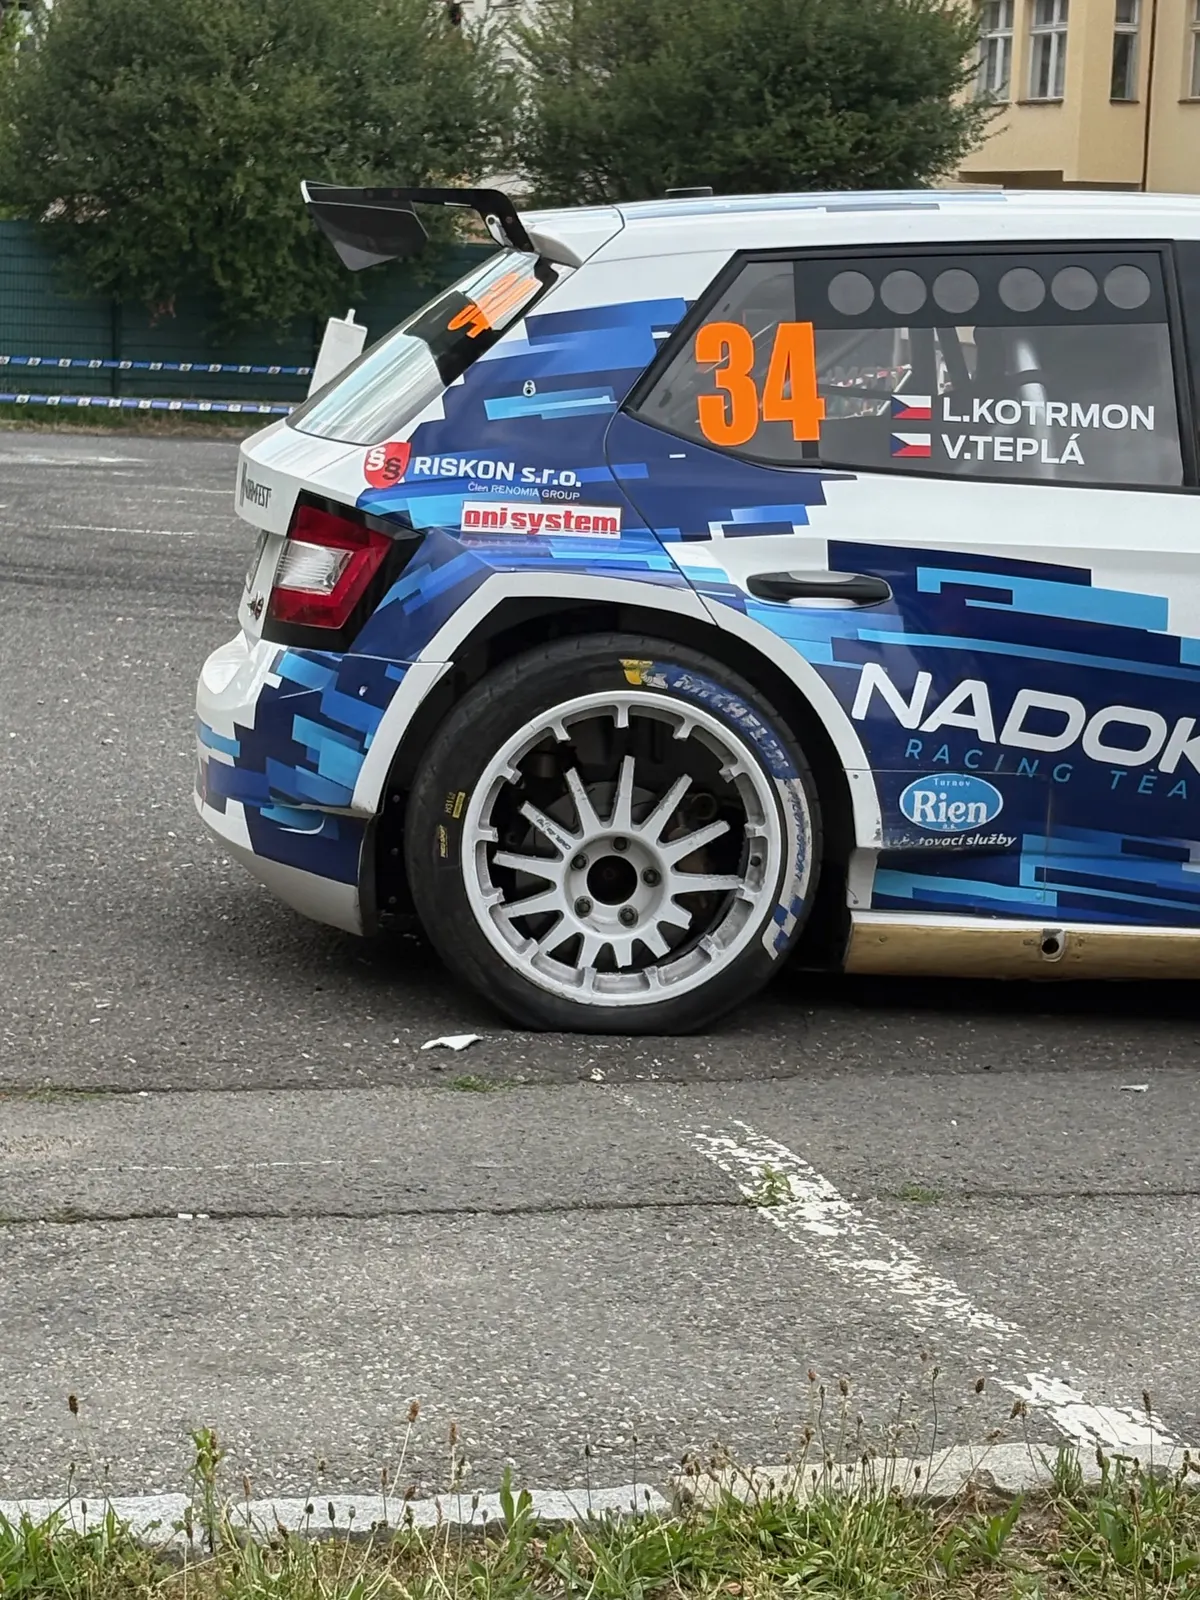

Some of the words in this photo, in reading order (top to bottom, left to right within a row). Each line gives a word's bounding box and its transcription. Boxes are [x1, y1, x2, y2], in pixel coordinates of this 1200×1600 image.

[694, 321, 826, 447] 34
[941, 397, 1155, 432] L.KOTRMON
[940, 433, 1085, 465] V.TEPLÁ
[413, 456, 515, 481] RISKON
[521, 467, 582, 488] s.r.o.
[468, 481, 489, 493] Člen
[491, 485, 539, 497] RENOMIA
[542, 489, 580, 501] GROUP
[851, 662, 1200, 774] NADOK
[905, 739, 1073, 782] RACING
[933, 778, 971, 787] Turnov
[912, 790, 988, 823] Rien
[966, 833, 1017, 848] služby
